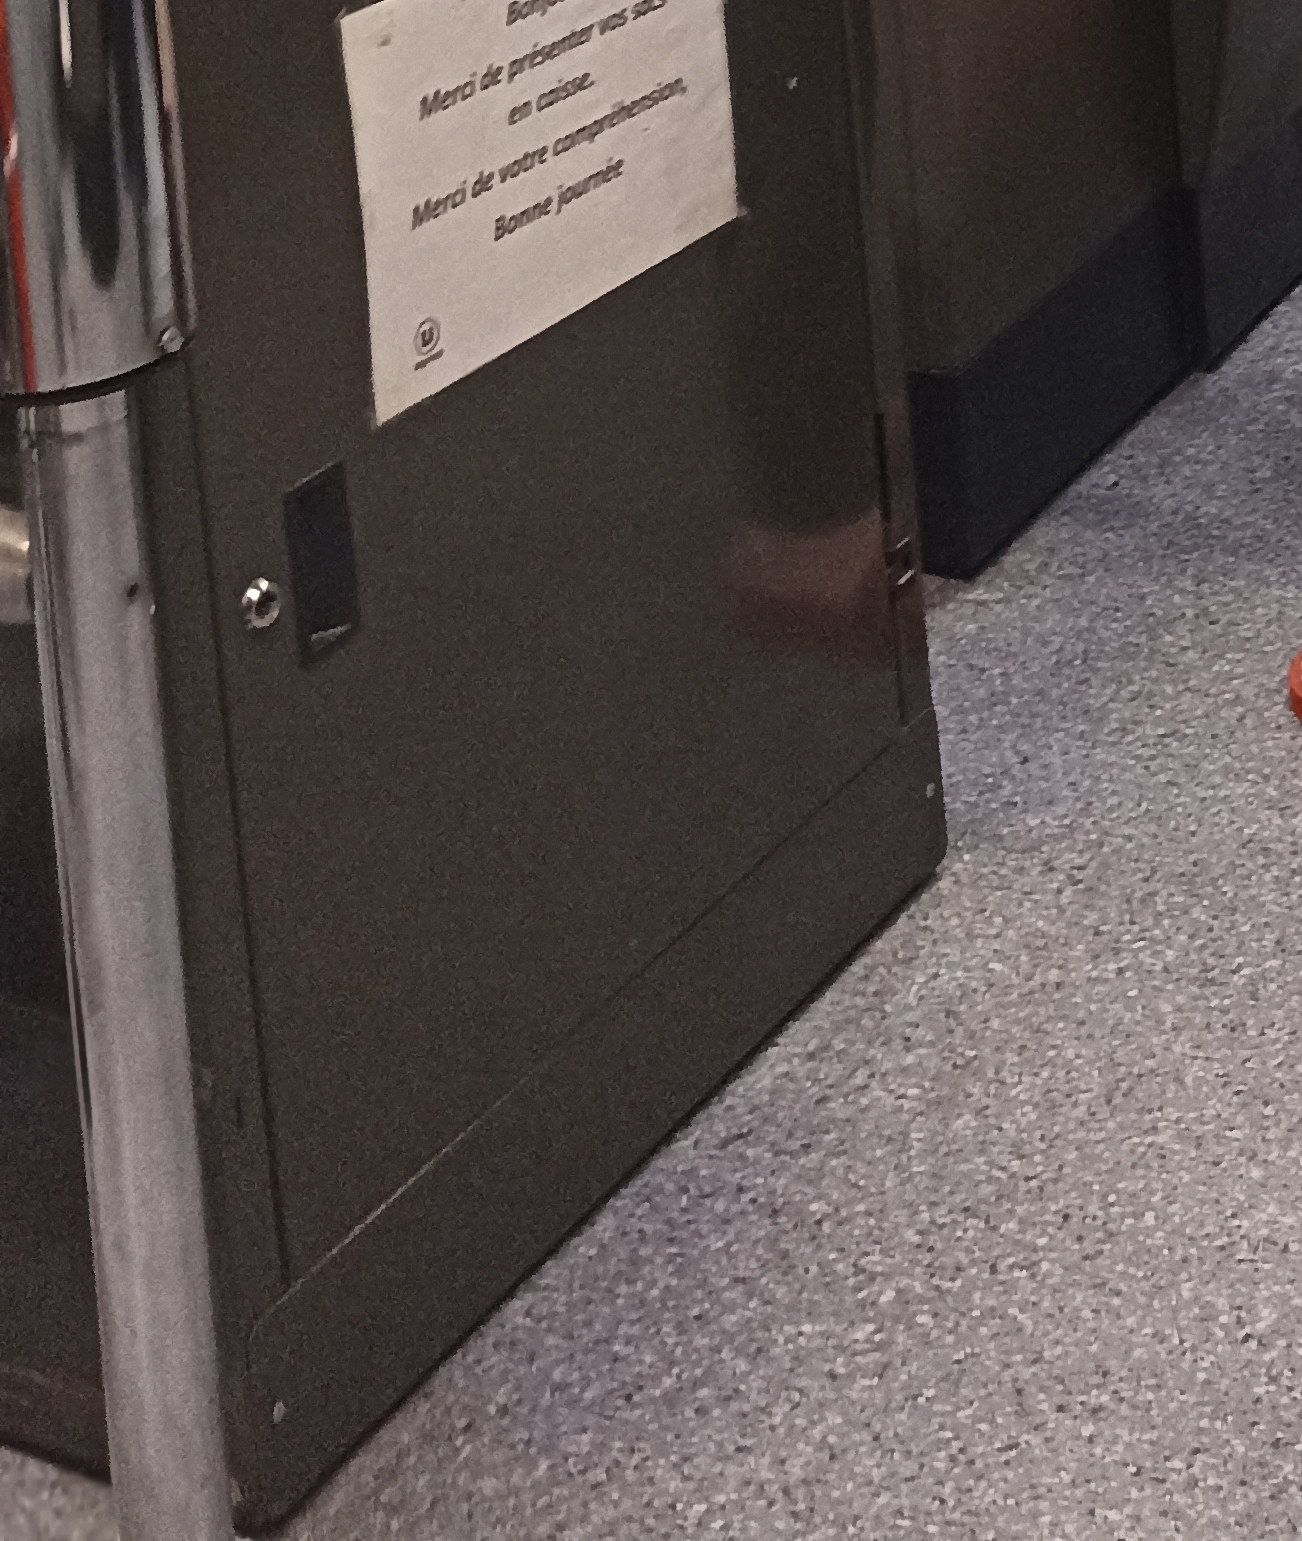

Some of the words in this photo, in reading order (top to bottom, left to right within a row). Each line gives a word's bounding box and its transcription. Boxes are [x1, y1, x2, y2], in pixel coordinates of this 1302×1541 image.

[418, 71, 477, 121] Merci
[479, 63, 504, 92] de
[507, 23, 596, 83] présenter
[596, 7, 629, 36] vos
[507, 98, 533, 126] en
[535, 72, 596, 113] caisse.
[411, 180, 467, 231] Merci
[471, 170, 495, 199] de
[498, 144, 549, 184] votre
[493, 195, 553, 242] Bonne
[555, 156, 625, 215] journée
